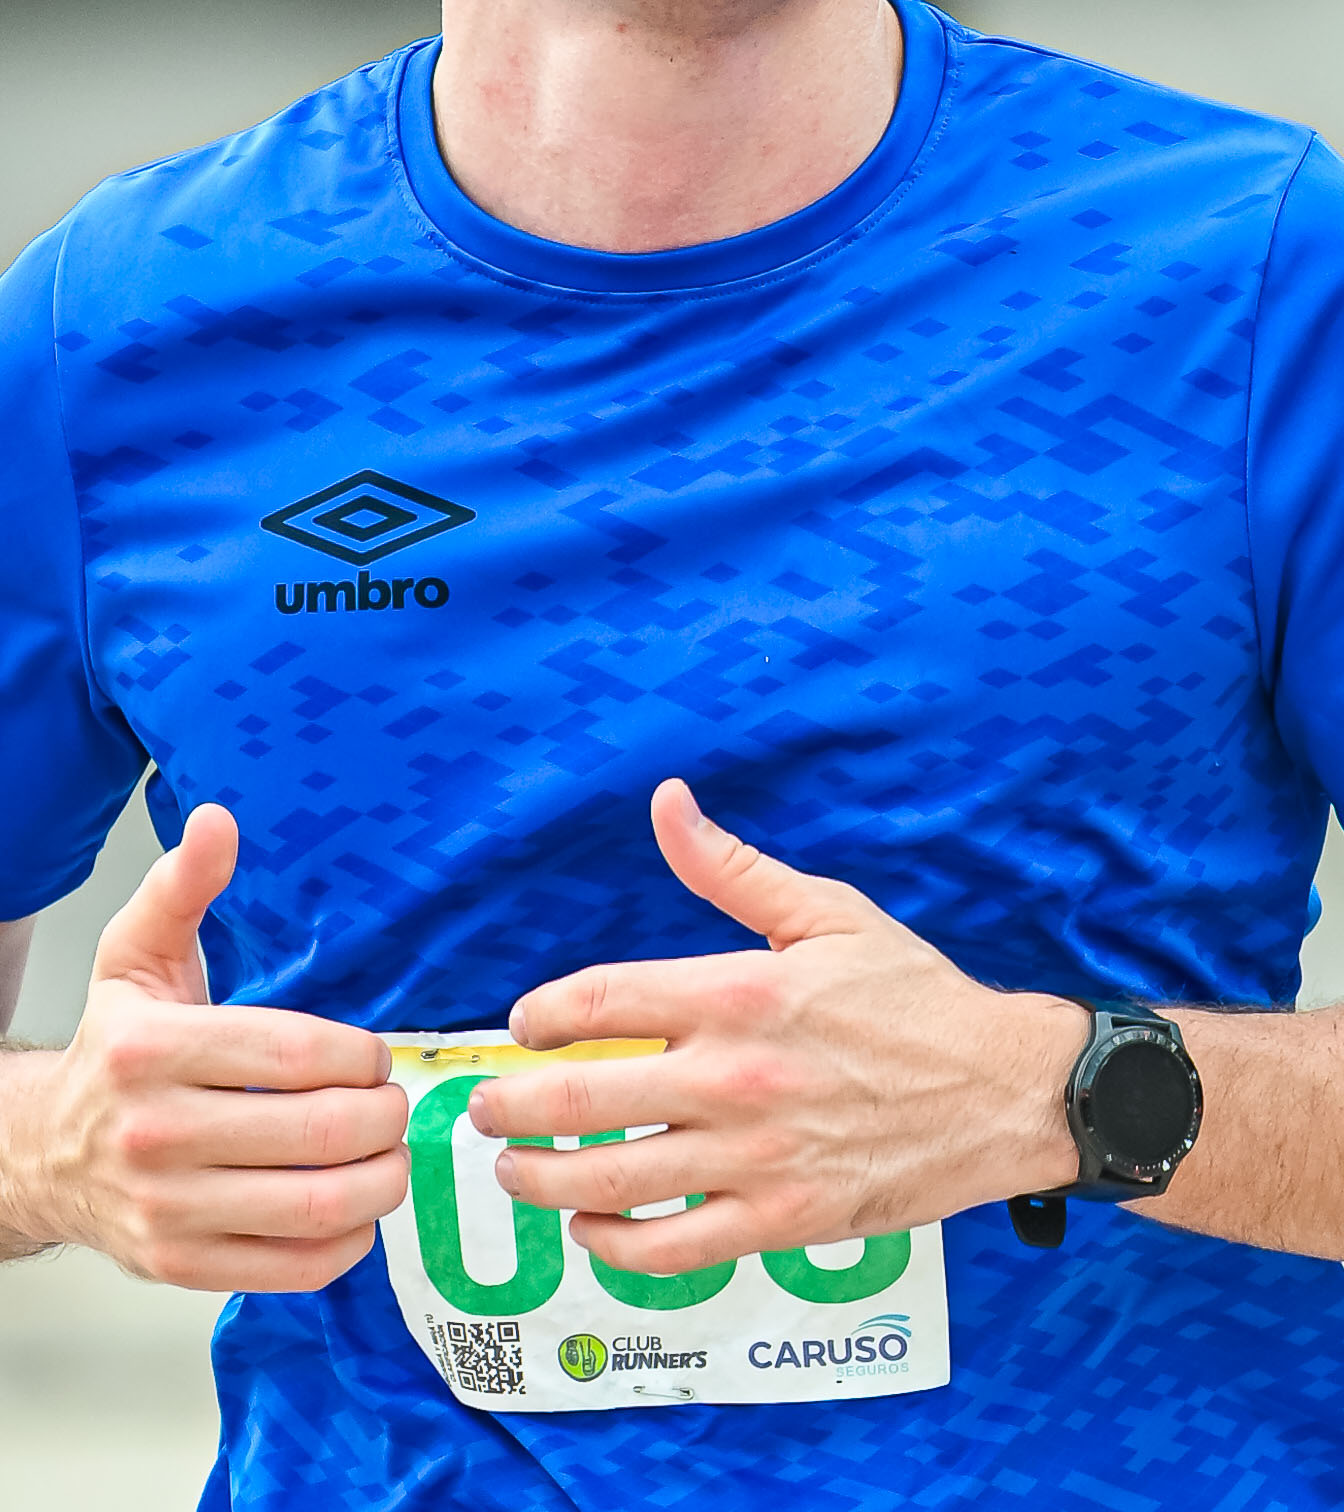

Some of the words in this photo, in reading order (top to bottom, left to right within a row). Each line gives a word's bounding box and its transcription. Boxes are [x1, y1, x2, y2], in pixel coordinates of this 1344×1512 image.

[274, 570, 450, 614] umbro
[612, 1336, 662, 1352] CLUB
[748, 1333, 908, 1369] CARUSO
[611, 1351, 708, 1371] RUNNER'S
[836, 1362, 910, 1378] SEGUROS
